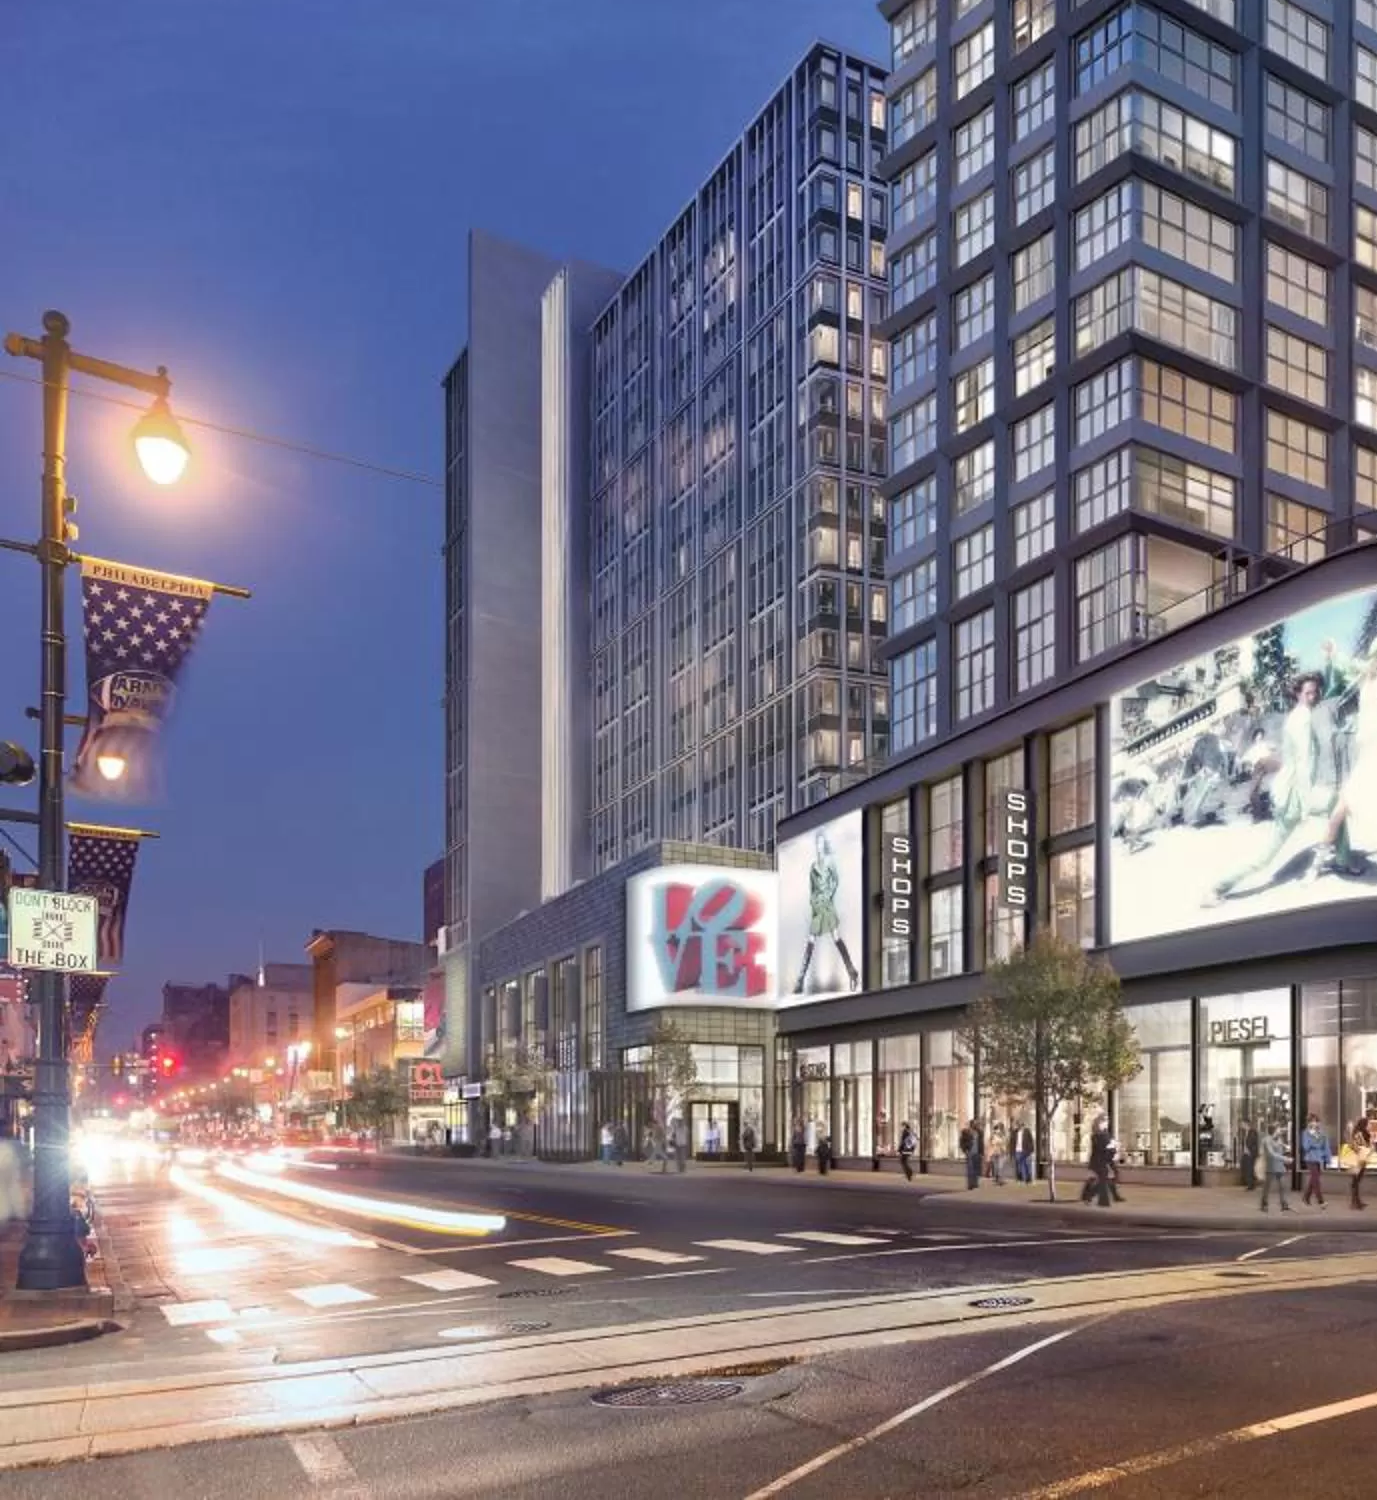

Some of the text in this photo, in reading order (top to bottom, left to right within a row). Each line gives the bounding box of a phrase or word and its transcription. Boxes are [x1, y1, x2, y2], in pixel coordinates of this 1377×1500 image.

[92, 563, 204, 596] PHILADELPHIA
[1006, 792, 1028, 905] SHOPS
[891, 837, 912, 935] SHOPS
[53, 897, 92, 913] BLOCK
[15, 948, 89, 969] THE BOX
